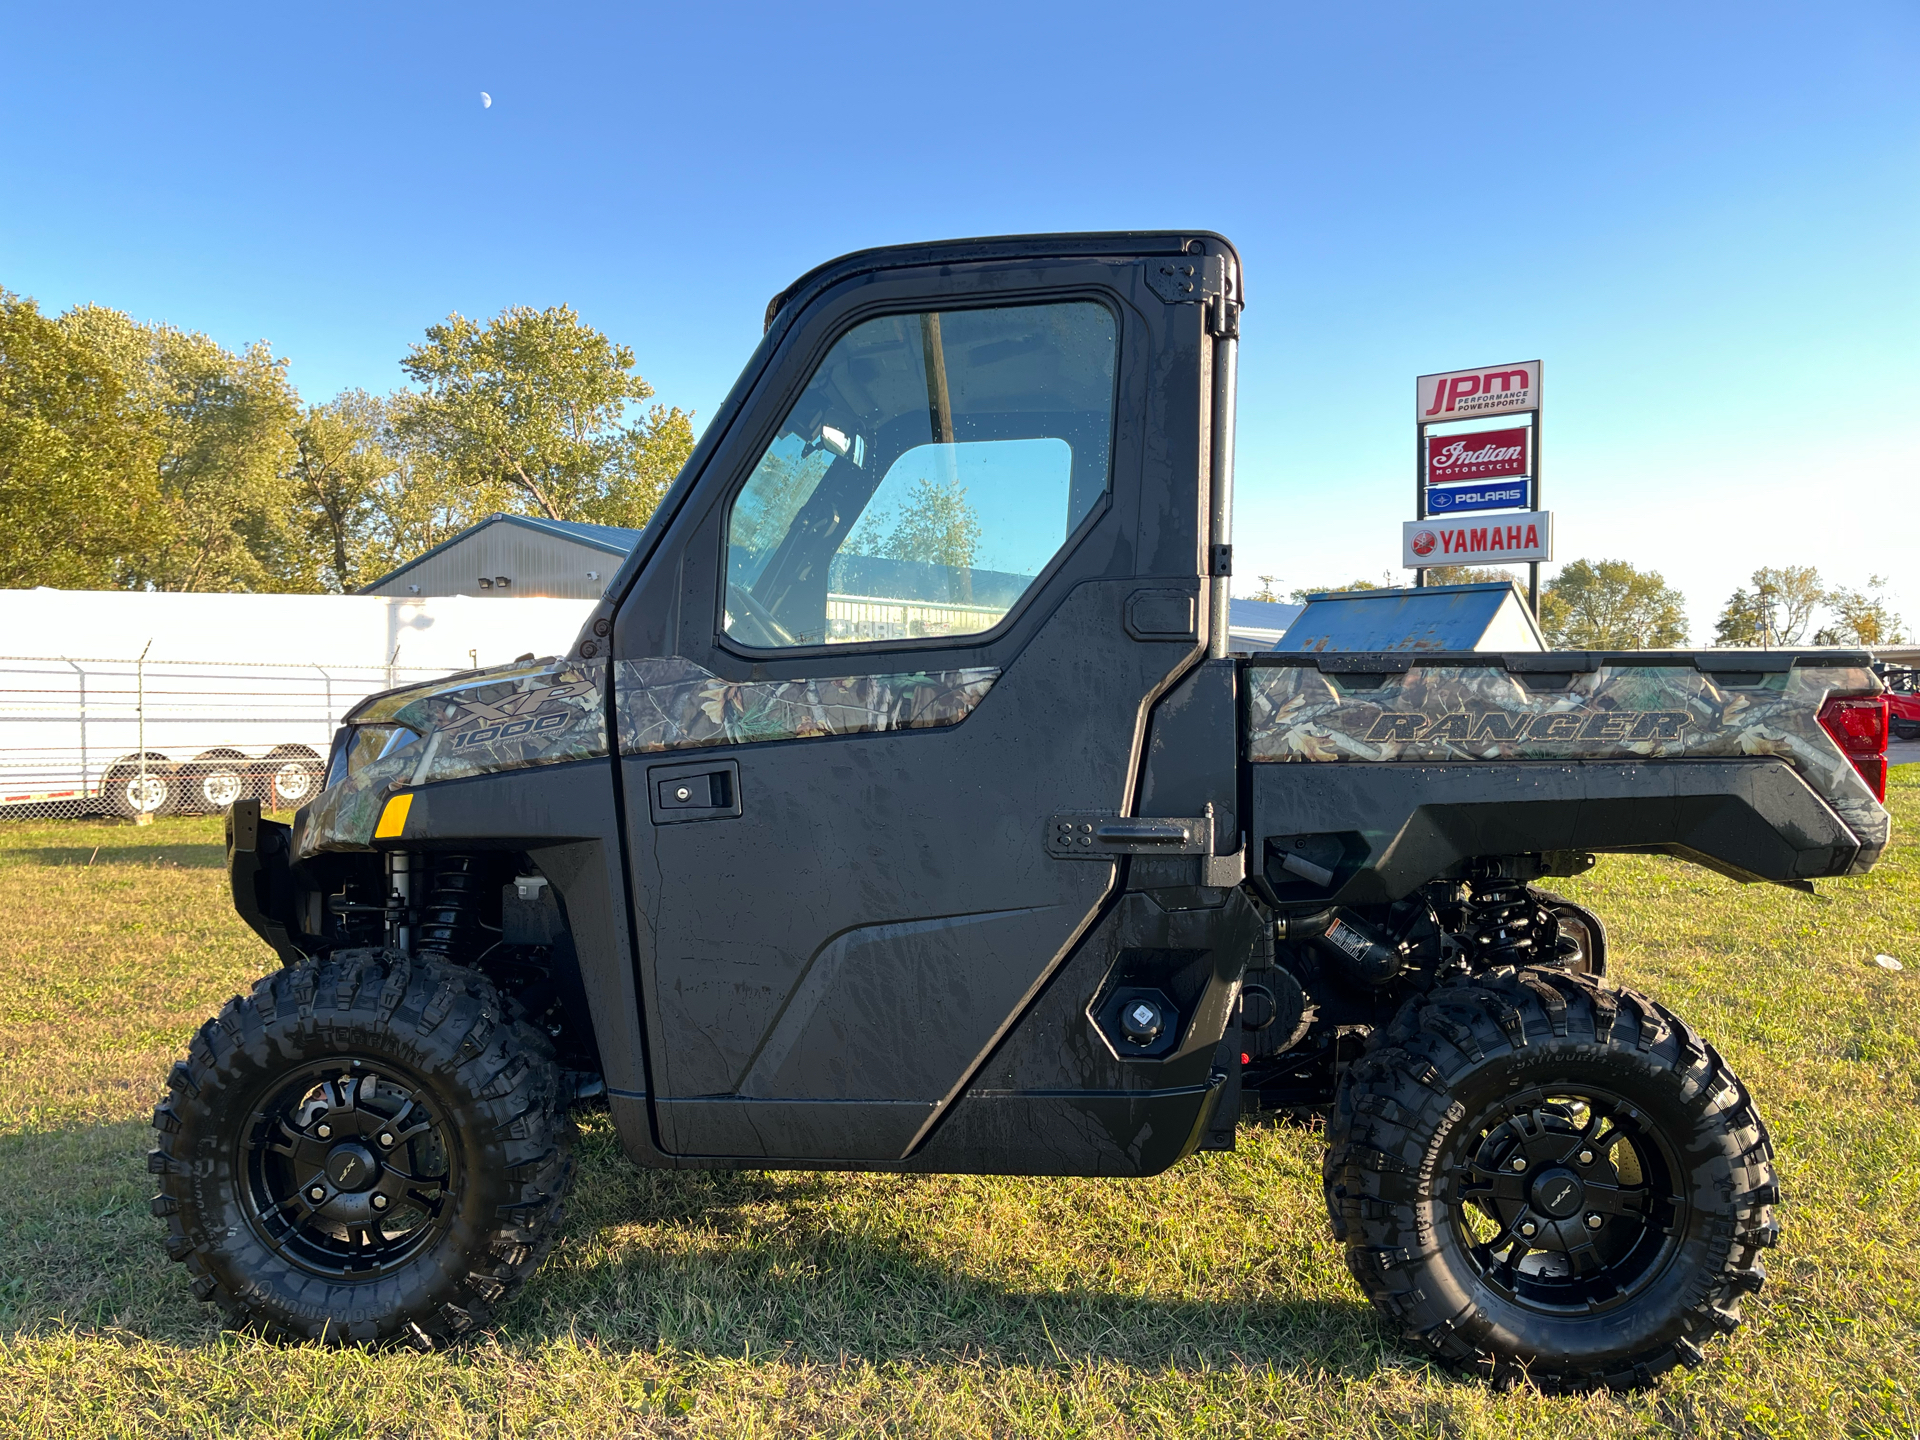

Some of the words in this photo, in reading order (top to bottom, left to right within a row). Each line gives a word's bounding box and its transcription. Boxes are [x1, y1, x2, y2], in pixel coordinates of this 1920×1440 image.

[1458, 390, 1529, 405] PERFORMANCE
[1458, 398, 1526, 412] POWERSPORTS
[1432, 441, 1522, 468] Indian
[1436, 462, 1519, 475] MOTORCYCLE
[1455, 489, 1521, 504] POLARIS
[1439, 524, 1540, 554] YAMAHA
[433, 680, 597, 733] XP
[451, 711, 571, 751] 1000
[1363, 710, 1695, 743] RANGER
